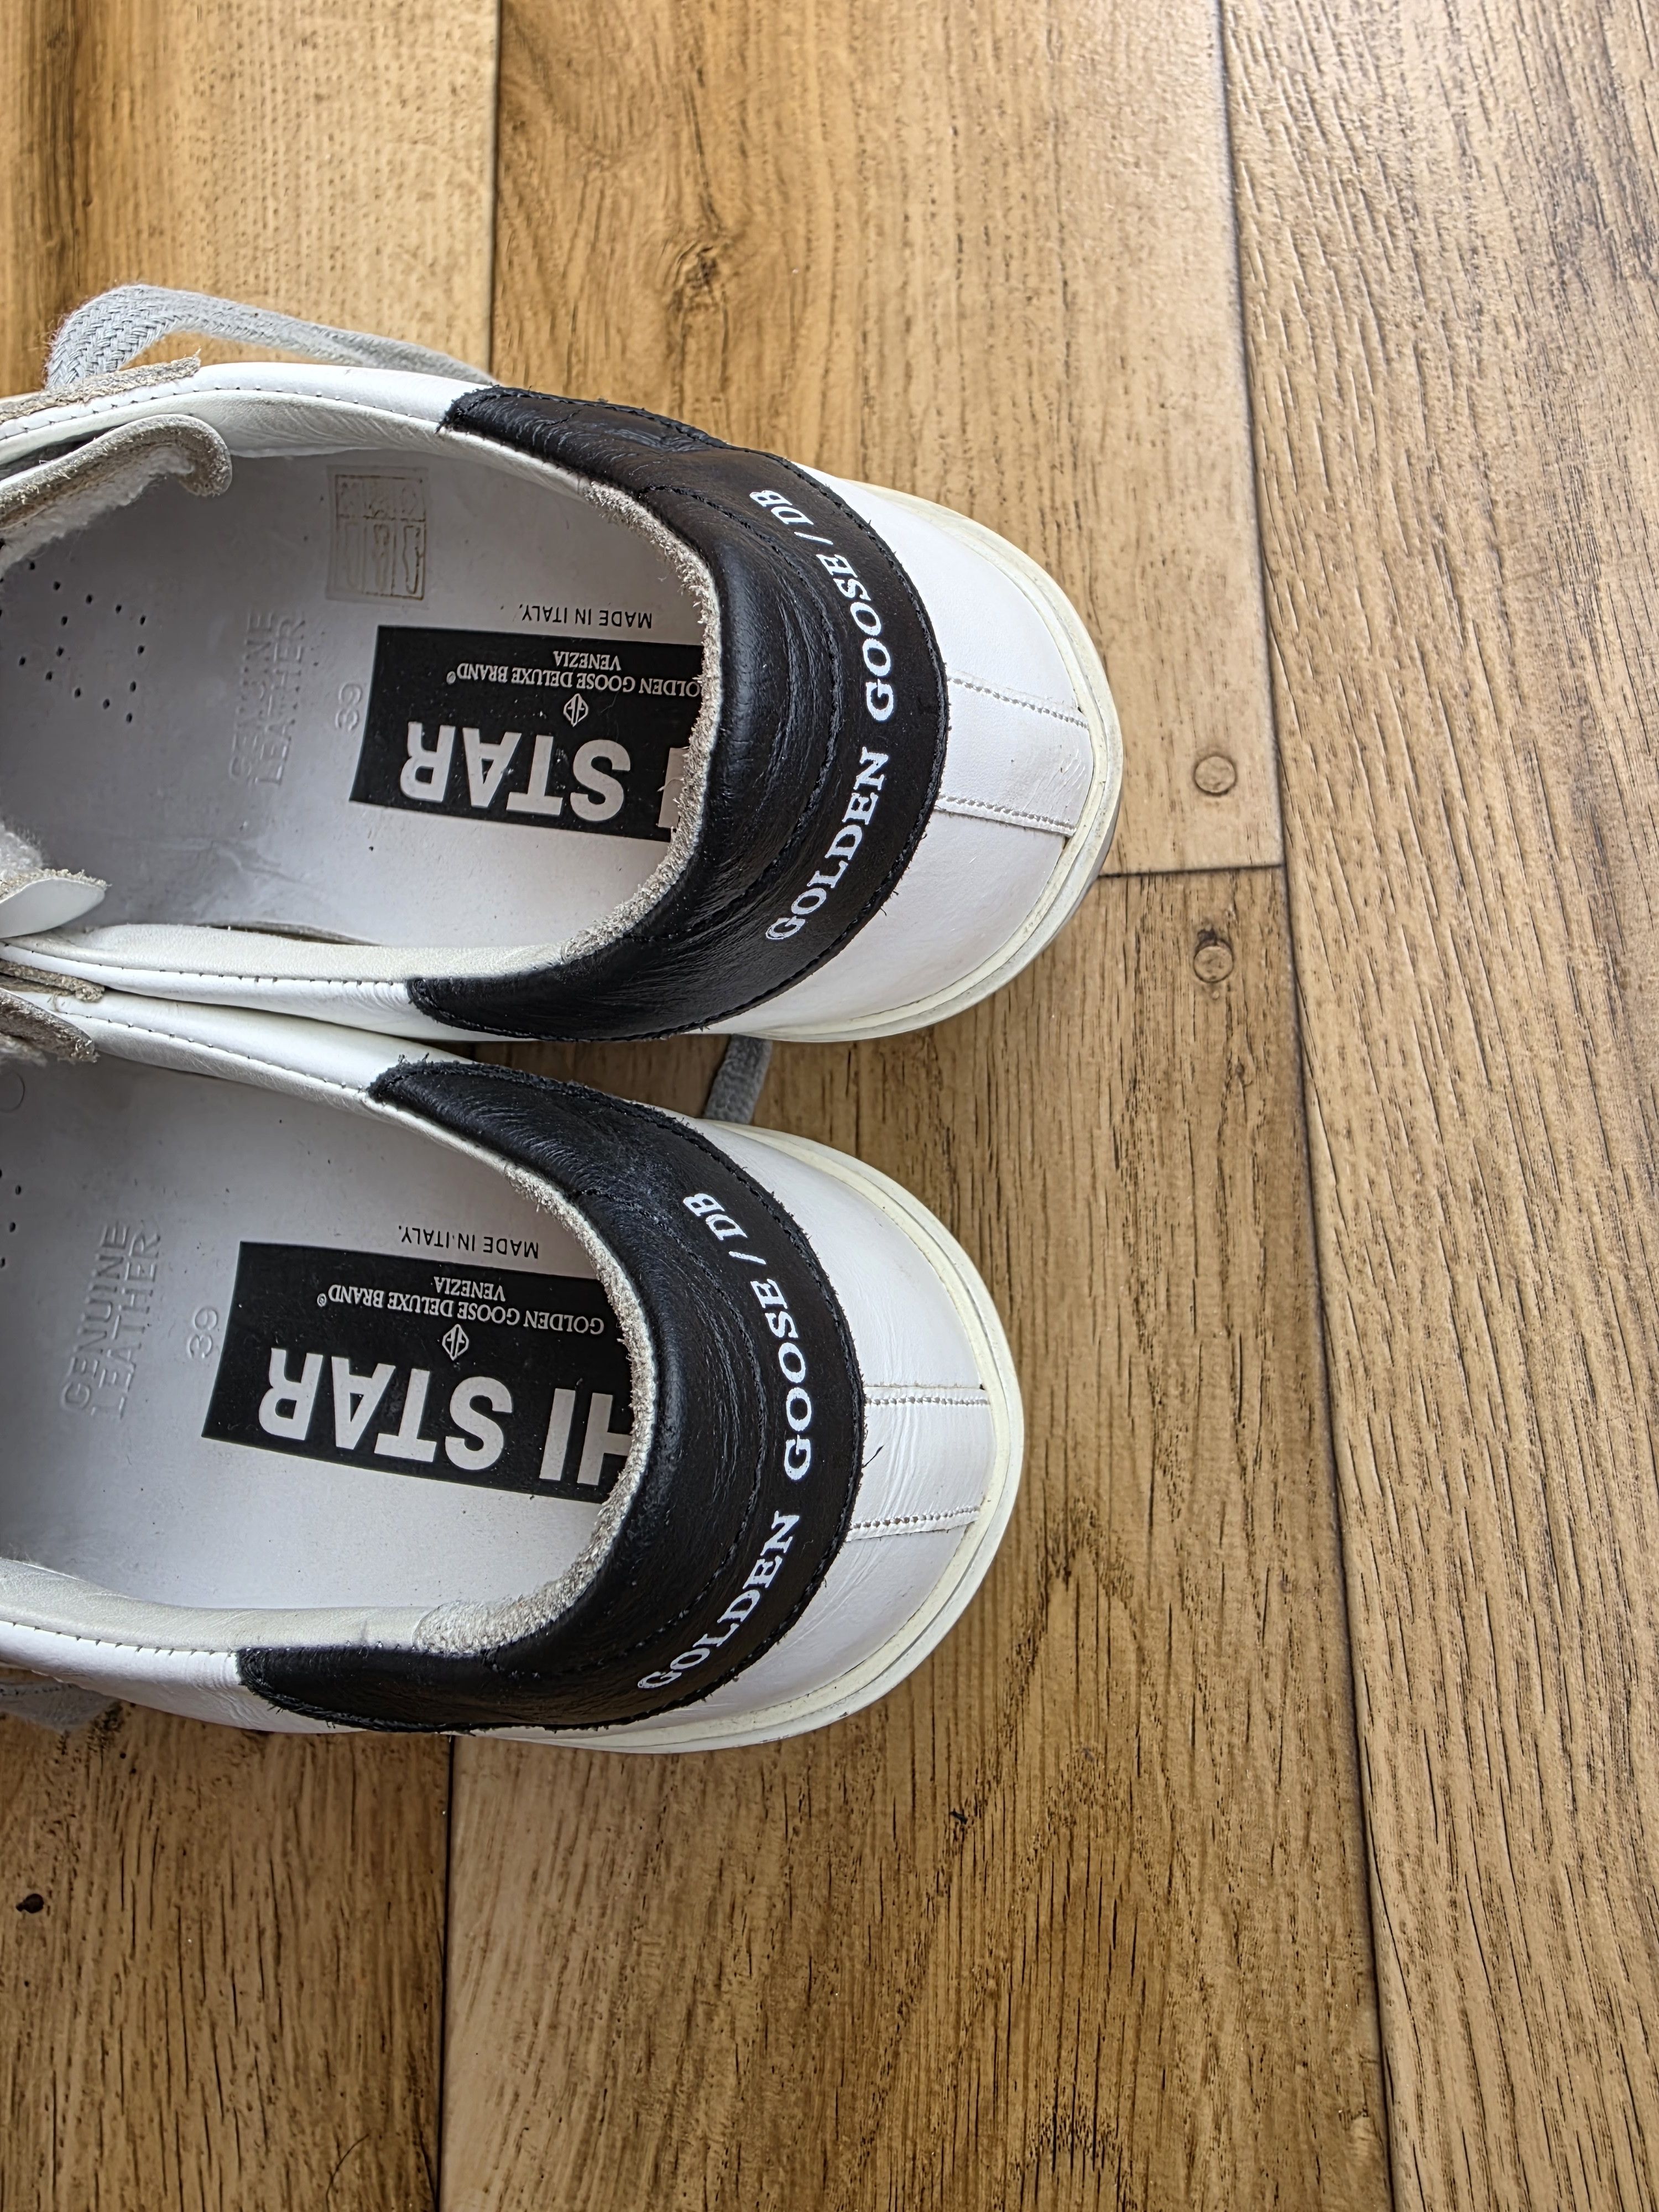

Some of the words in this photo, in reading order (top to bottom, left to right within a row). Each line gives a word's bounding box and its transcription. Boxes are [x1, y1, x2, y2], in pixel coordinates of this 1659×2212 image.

[749, 489, 813, 526] DB
[519, 604, 567, 623] ITALY.
[576, 611, 591, 625] IN
[599, 610, 652, 629] MADE
[817, 553, 894, 723] GOOSE
[553, 650, 622, 671] VENEZIA
[512, 667, 573, 688] DELUXE
[576, 672, 635, 693] GOOSE
[639, 678, 702, 697] OLDEN
[336, 682, 363, 732] 39
[400, 721, 630, 822] STAR
[765, 747, 889, 940] GOLDEN
[683, 1192, 749, 1242] DB
[398, 1225, 449, 1248] ITALY.
[458, 1233, 474, 1251] IN
[483, 1237, 539, 1259] MADE
[434, 1276, 505, 1302] VENEZIA
[60, 1222, 130, 1412] GENUINE
[388, 1292, 453, 1317] DELUXE
[457, 1302, 520, 1326] GOOSE
[91, 1231, 161, 1419] LEATHER
[186, 1306, 218, 1359] 39
[524, 1311, 604, 1334] GOLDEN
[750, 1278, 812, 1481] GOOSE
[258, 1348, 513, 1470] STAR
[539, 1387, 632, 1485] HI
[638, 1510, 800, 1689] GOLDEN
